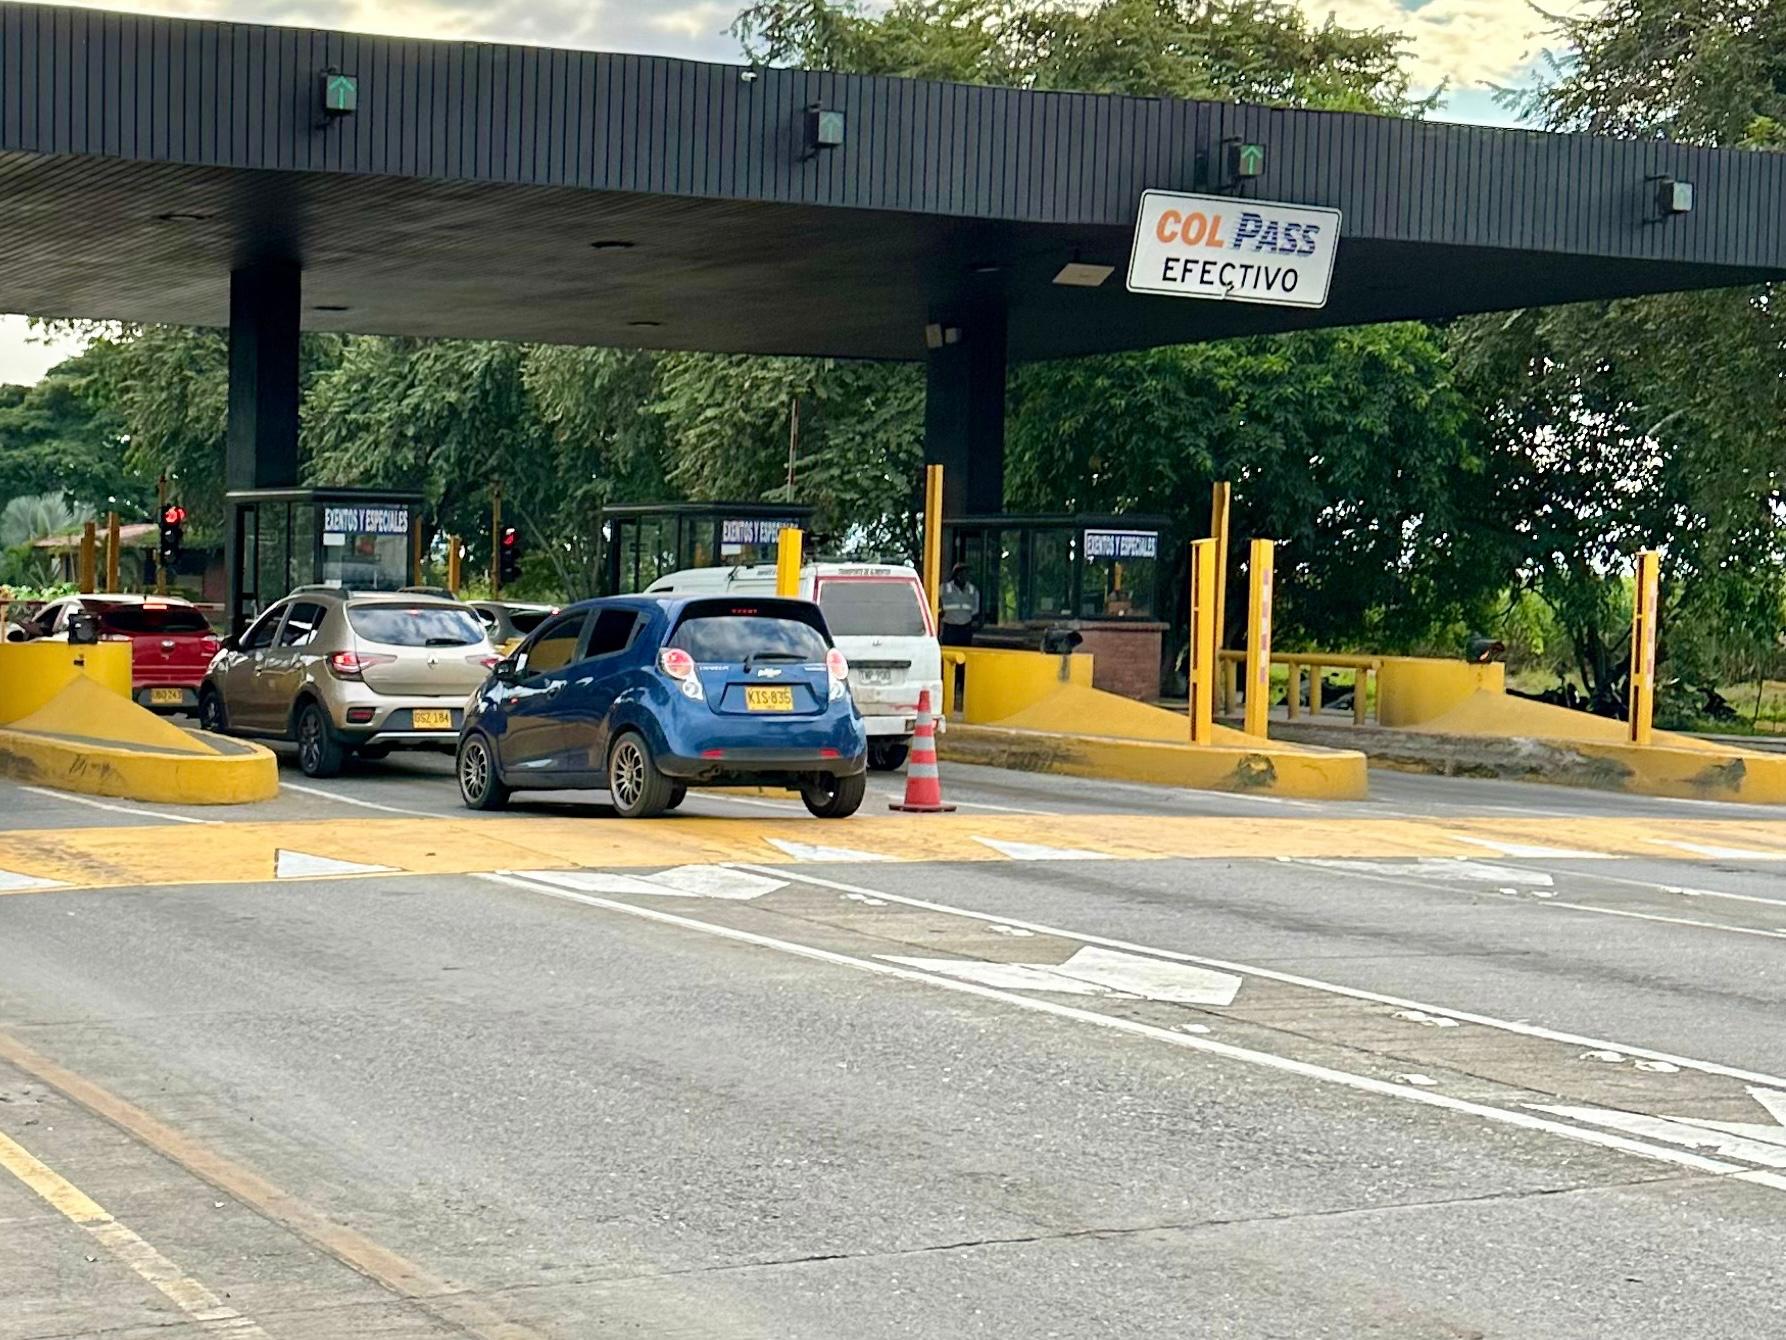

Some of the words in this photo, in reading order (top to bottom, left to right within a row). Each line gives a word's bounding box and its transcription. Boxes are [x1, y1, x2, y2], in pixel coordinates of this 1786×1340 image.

[1156, 209, 1225, 249] COL
[1232, 211, 1320, 257] PASS
[1162, 256, 1299, 293] EFECTIVO
[324, 508, 358, 532] EXENTOS
[359, 509, 366, 532] Y
[366, 509, 408, 533] ESPECIALES
[722, 520, 753, 543] EXENTOS
[753, 521, 760, 543] Y
[1087, 535, 1115, 556] EXENTOS
[1115, 536, 1120, 556] Y
[1120, 536, 1156, 557] ESPECIALES
